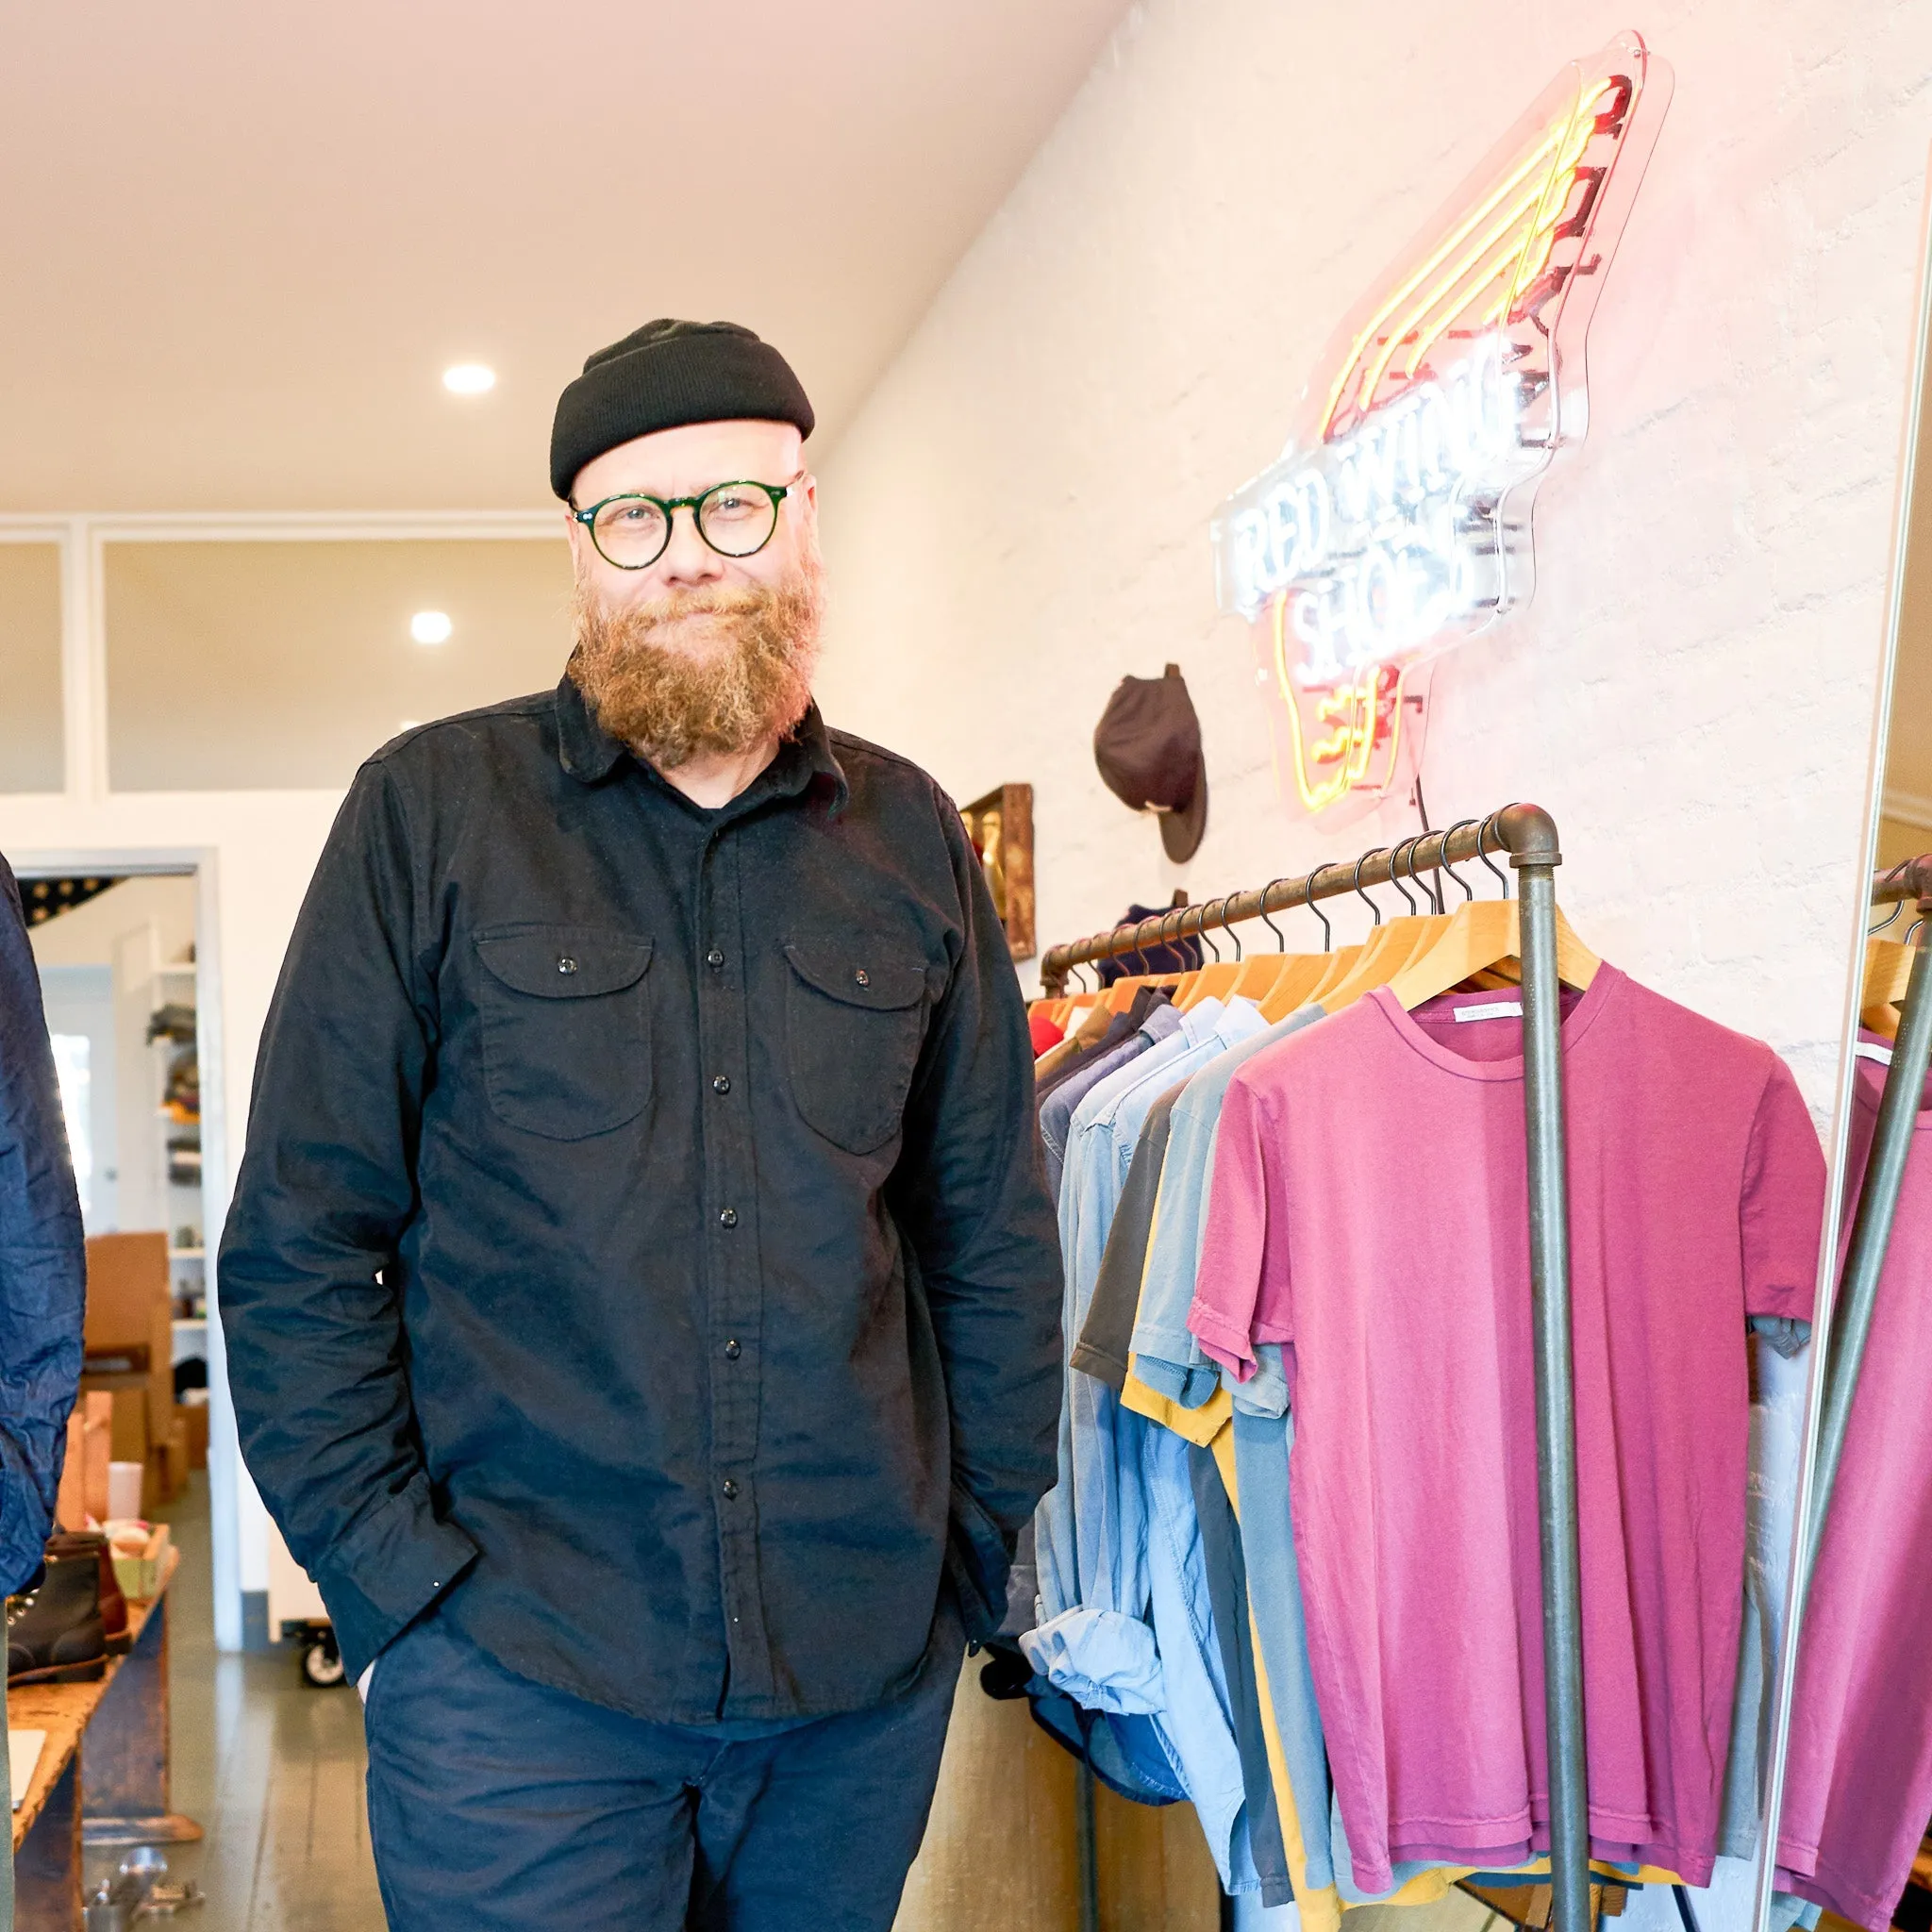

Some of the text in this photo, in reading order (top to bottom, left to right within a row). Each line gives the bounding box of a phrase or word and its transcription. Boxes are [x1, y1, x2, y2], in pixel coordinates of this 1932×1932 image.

[1234, 333, 1521, 606] RED WING
[1293, 505, 1474, 684] SHOES
